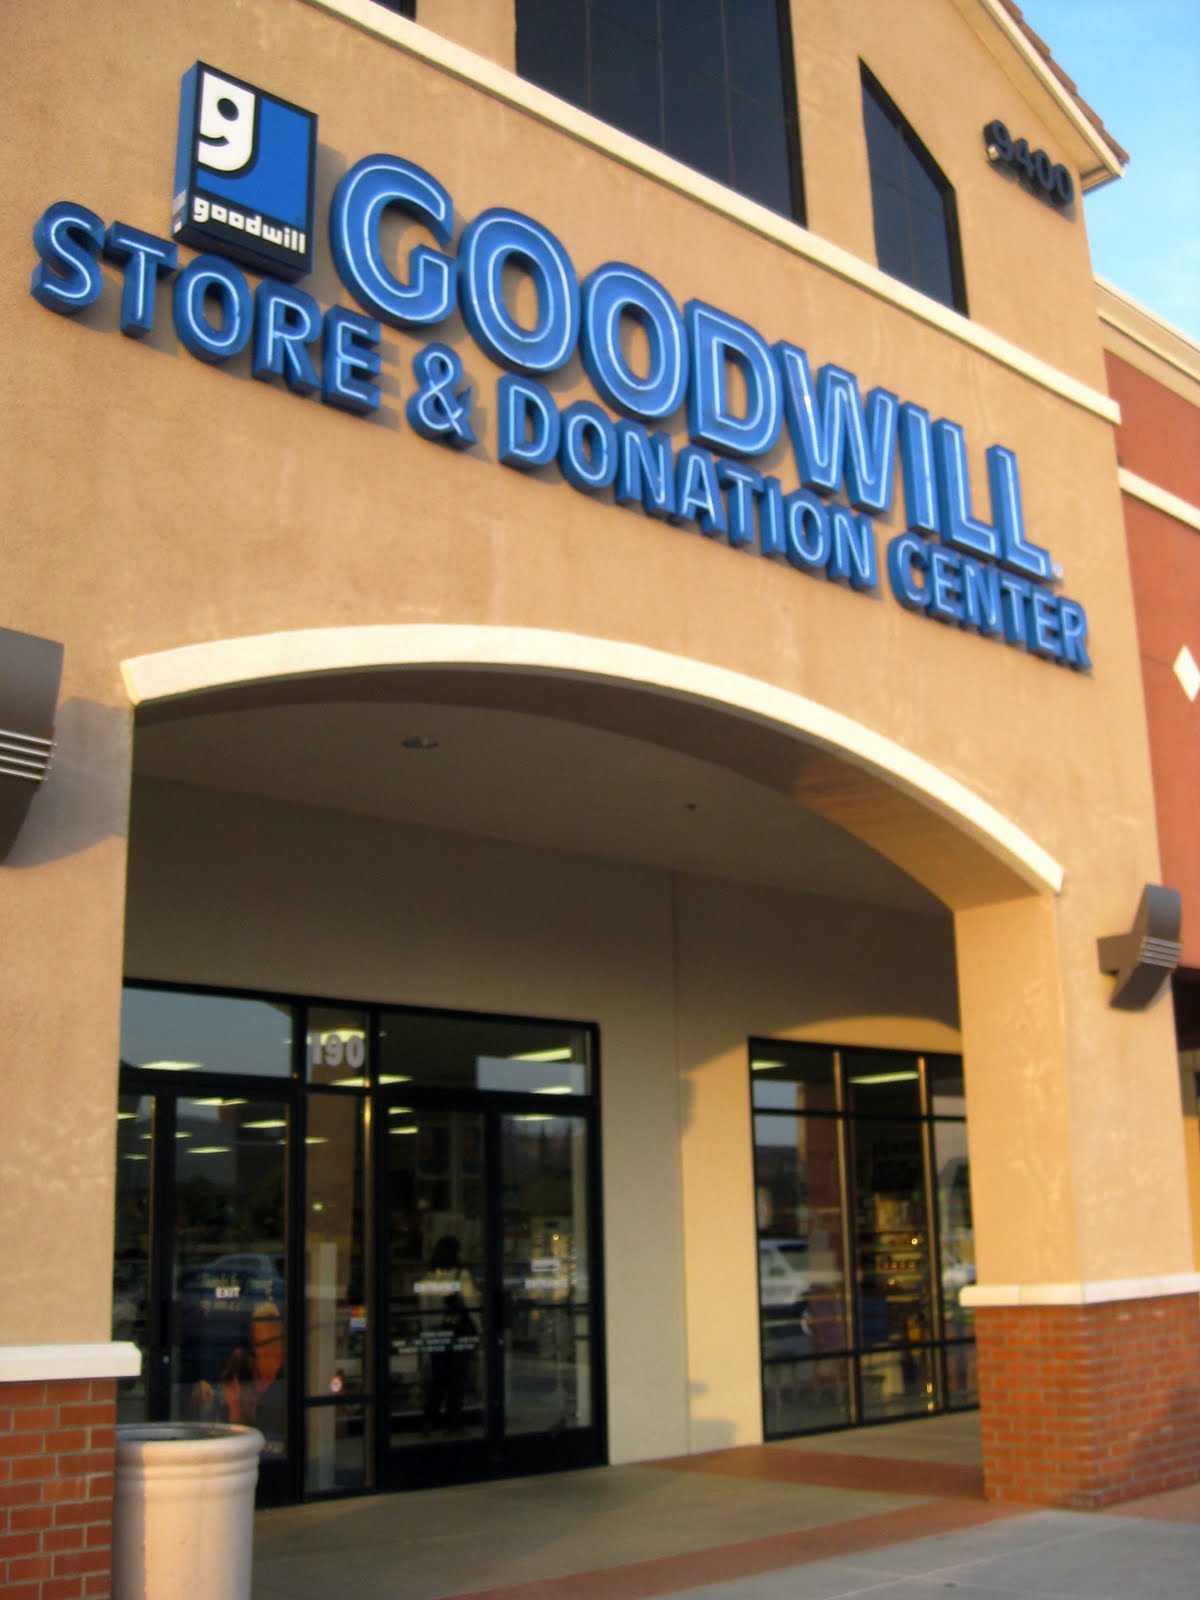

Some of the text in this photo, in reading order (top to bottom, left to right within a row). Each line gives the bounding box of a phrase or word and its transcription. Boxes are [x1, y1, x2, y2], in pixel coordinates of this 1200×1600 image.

[983, 119, 1075, 208] 9400
[192, 196, 307, 255] goodwill
[329, 153, 1053, 581] GOODWILL
[31, 201, 1092, 675] STORE & DONATION CENTER
[309, 1031, 365, 1068] 190
